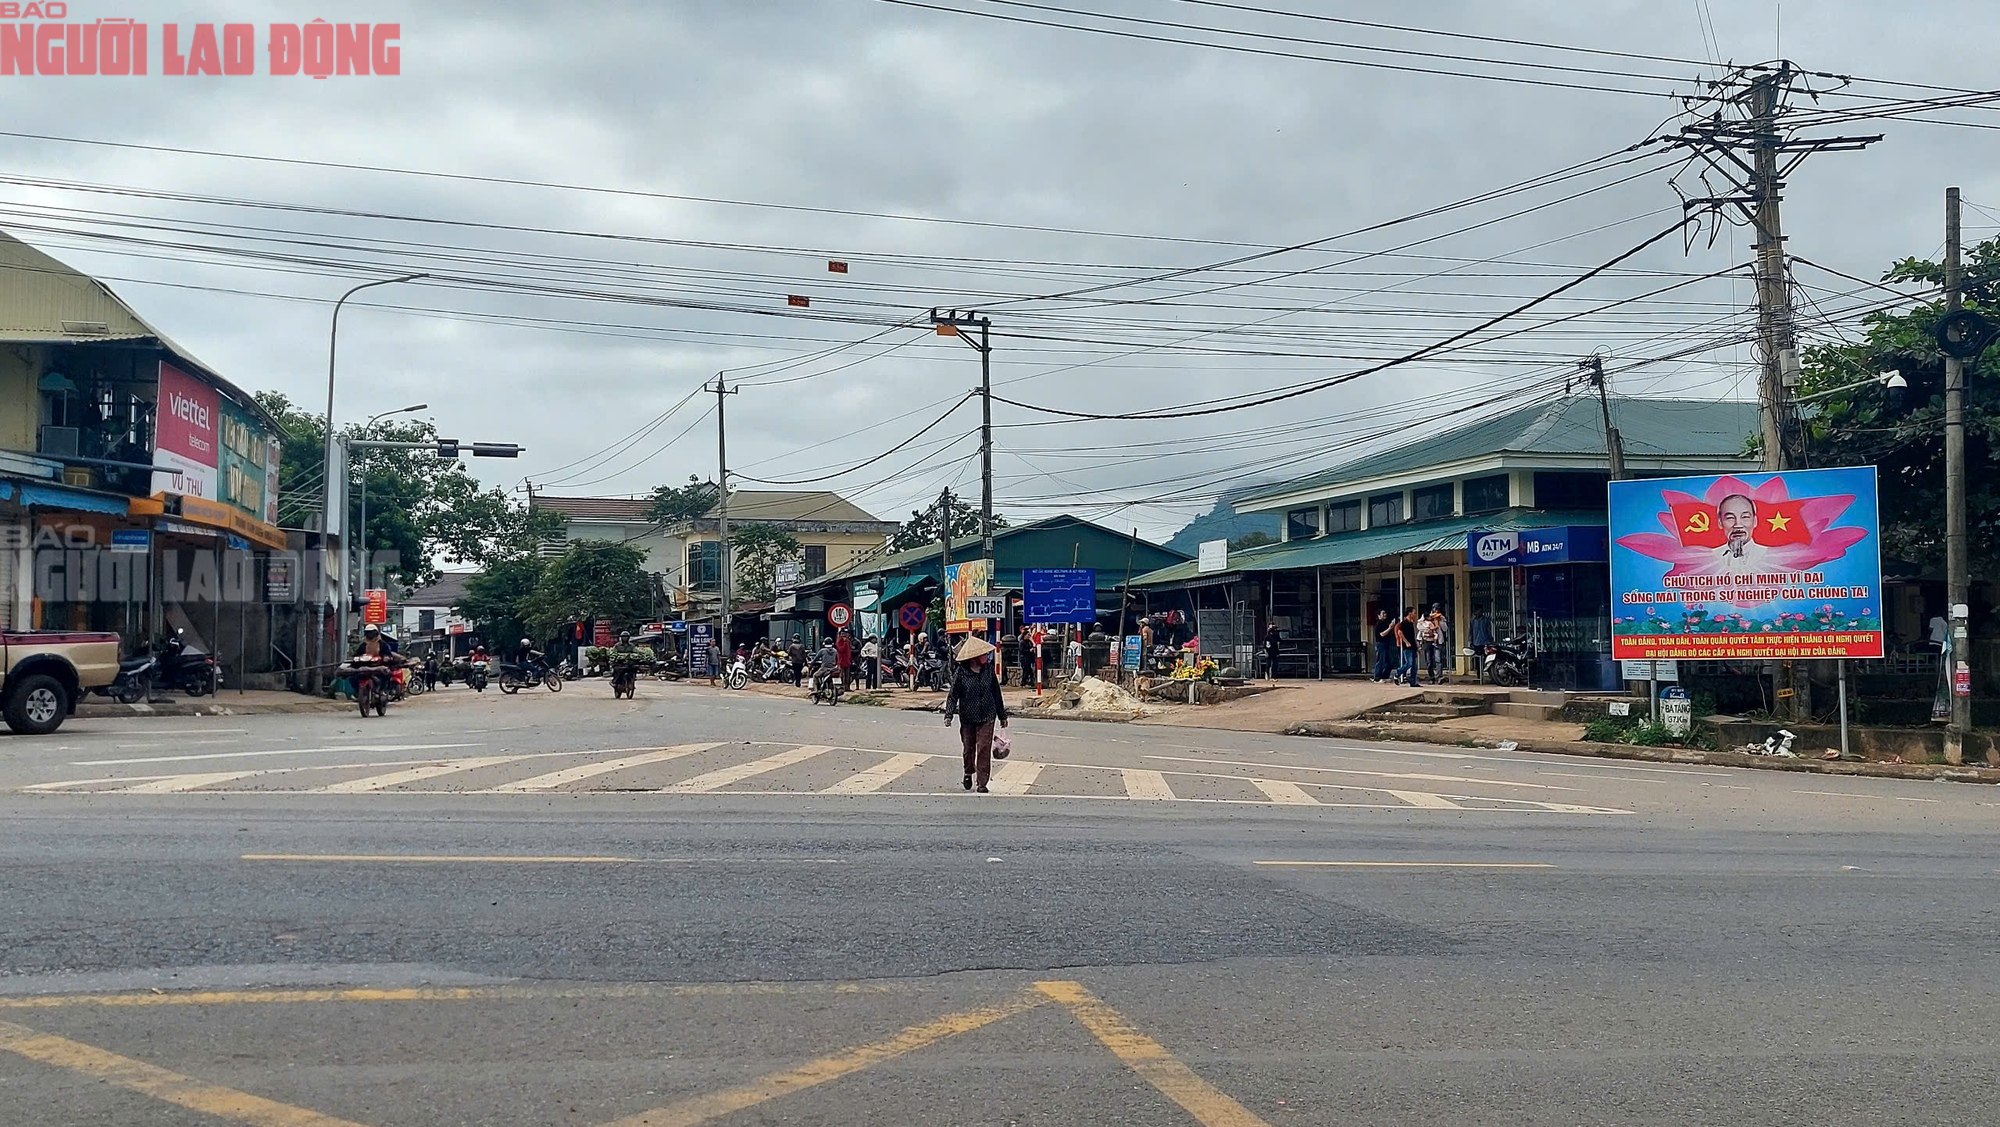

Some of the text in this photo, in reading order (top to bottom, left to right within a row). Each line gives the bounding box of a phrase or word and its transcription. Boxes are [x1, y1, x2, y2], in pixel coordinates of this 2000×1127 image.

[169, 391, 211, 431] viettel
[188, 433, 210, 454] telecom
[1482, 539, 1511, 551] ATM
[1527, 541, 1540, 553] MB
[1664, 572, 1686, 588] CHỦ
[1689, 575, 1713, 589] TỊCH
[1734, 573, 1753, 586] CHÍ
[1756, 574, 1787, 585] MINH
[1804, 572, 1823, 585] ĐẠI
[1623, 585, 1869, 604] SỐNG MÃI TRONG SỰ NGHIỆP CỦA CHÚNG TA!
[968, 600, 1003, 615] ĐT.586
[1621, 636, 1638, 646] TOÀN
[1658, 636, 1675, 646] TOÀN
[1692, 636, 1709, 646] TOÀN
[1710, 635, 1728, 646] QUÂN
[1729, 634, 1749, 645] QUYẾT
[1750, 634, 1765, 645] TÂM
[1766, 634, 1783, 646] THỰC
[1783, 634, 1800, 646] HIỆN
[1853, 632, 1874, 644] QUYẾT
[1698, 646, 1711, 657] CÁC
[1712, 645, 1725, 656] CẤP
[1726, 647, 1736, 656] VÀ
[1753, 646, 1774, 657] QUYẾT
[1812, 646, 1827, 656] CỦA
